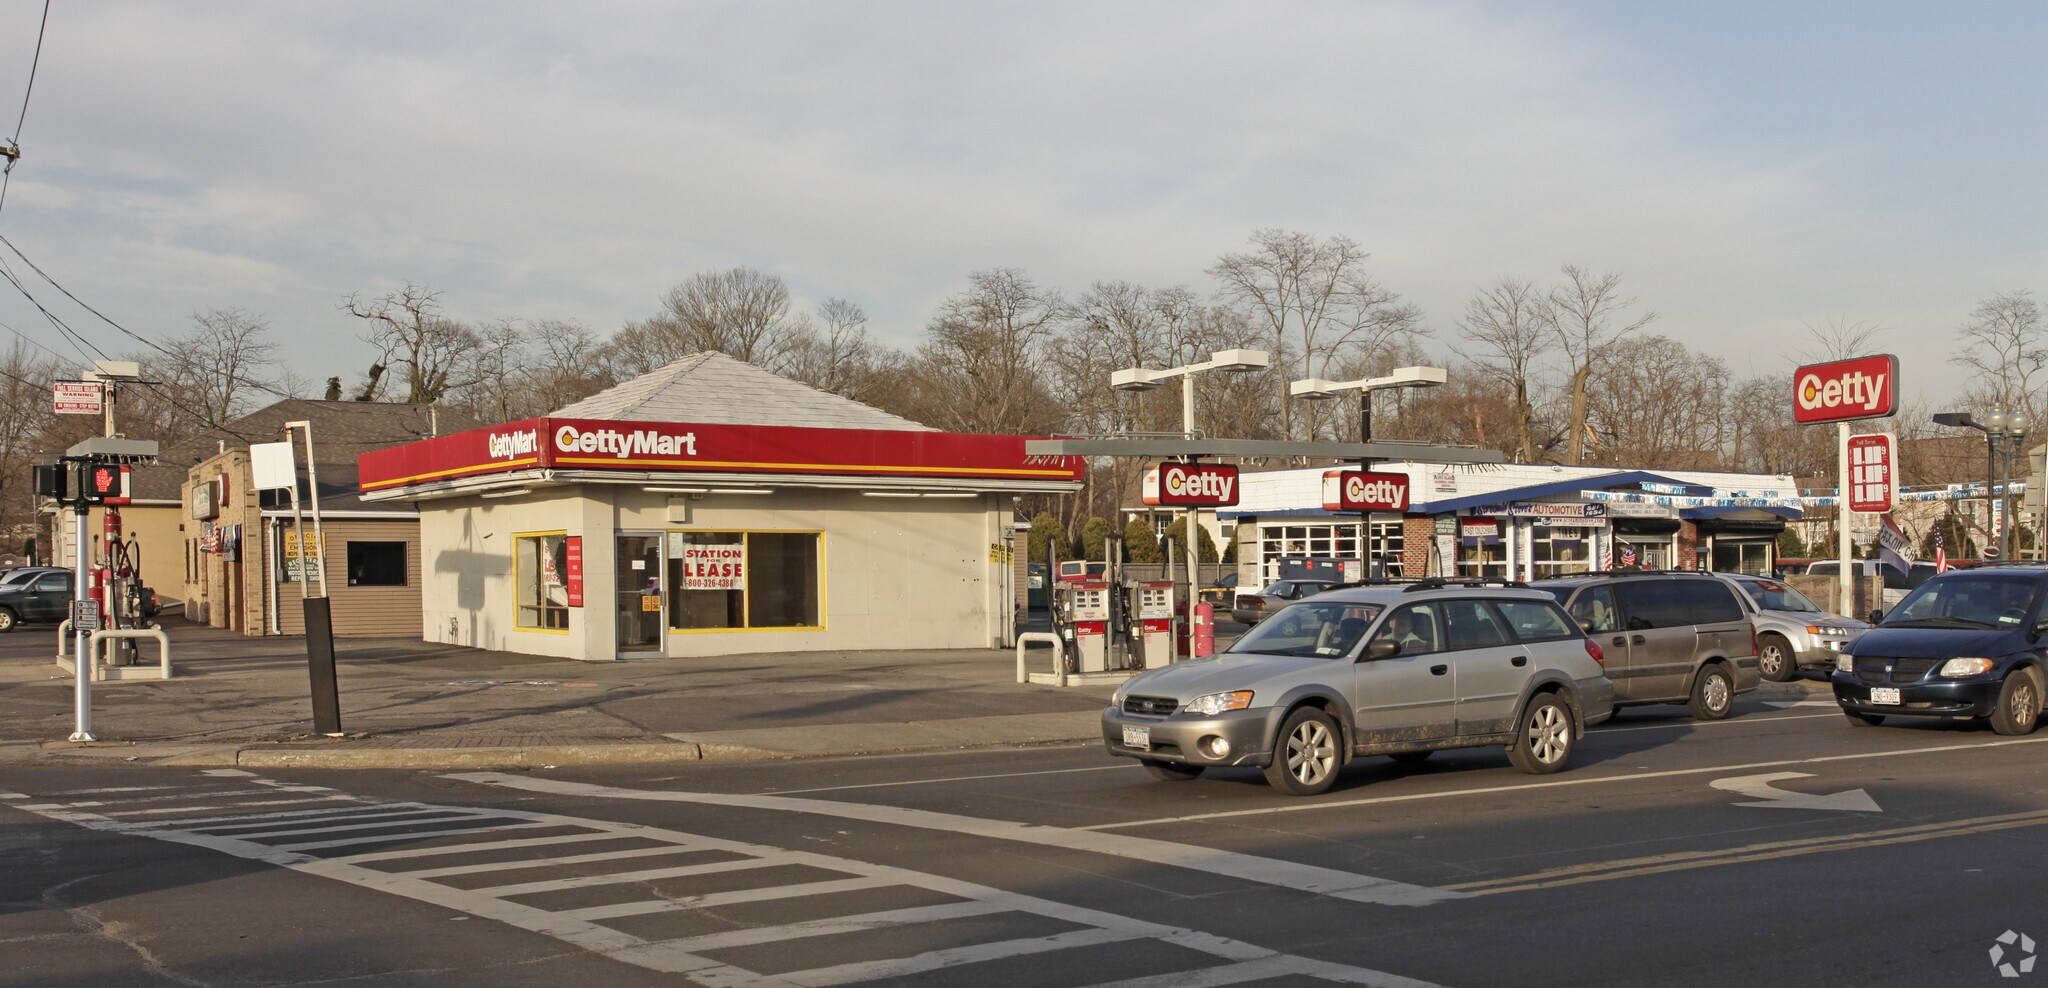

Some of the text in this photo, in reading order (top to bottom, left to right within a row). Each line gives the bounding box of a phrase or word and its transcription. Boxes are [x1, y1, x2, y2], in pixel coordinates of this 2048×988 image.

[1798, 371, 1885, 411] Getty
[489, 429, 537, 460] GettyMart
[555, 426, 697, 458] GettyMart
[1881, 446, 1887, 455] 9
[1882, 465, 1888, 474] 9
[1166, 468, 1233, 502] Getty
[1883, 484, 1889, 493] 9
[1346, 476, 1405, 509] Getty
[1533, 504, 1583, 515] AUTOMOTIVE
[1557, 528, 1578, 538] TIRES
[686, 549, 742, 558] STATION
[684, 563, 743, 577] LEASE
[684, 579, 734, 588] 1-800-326-4388
